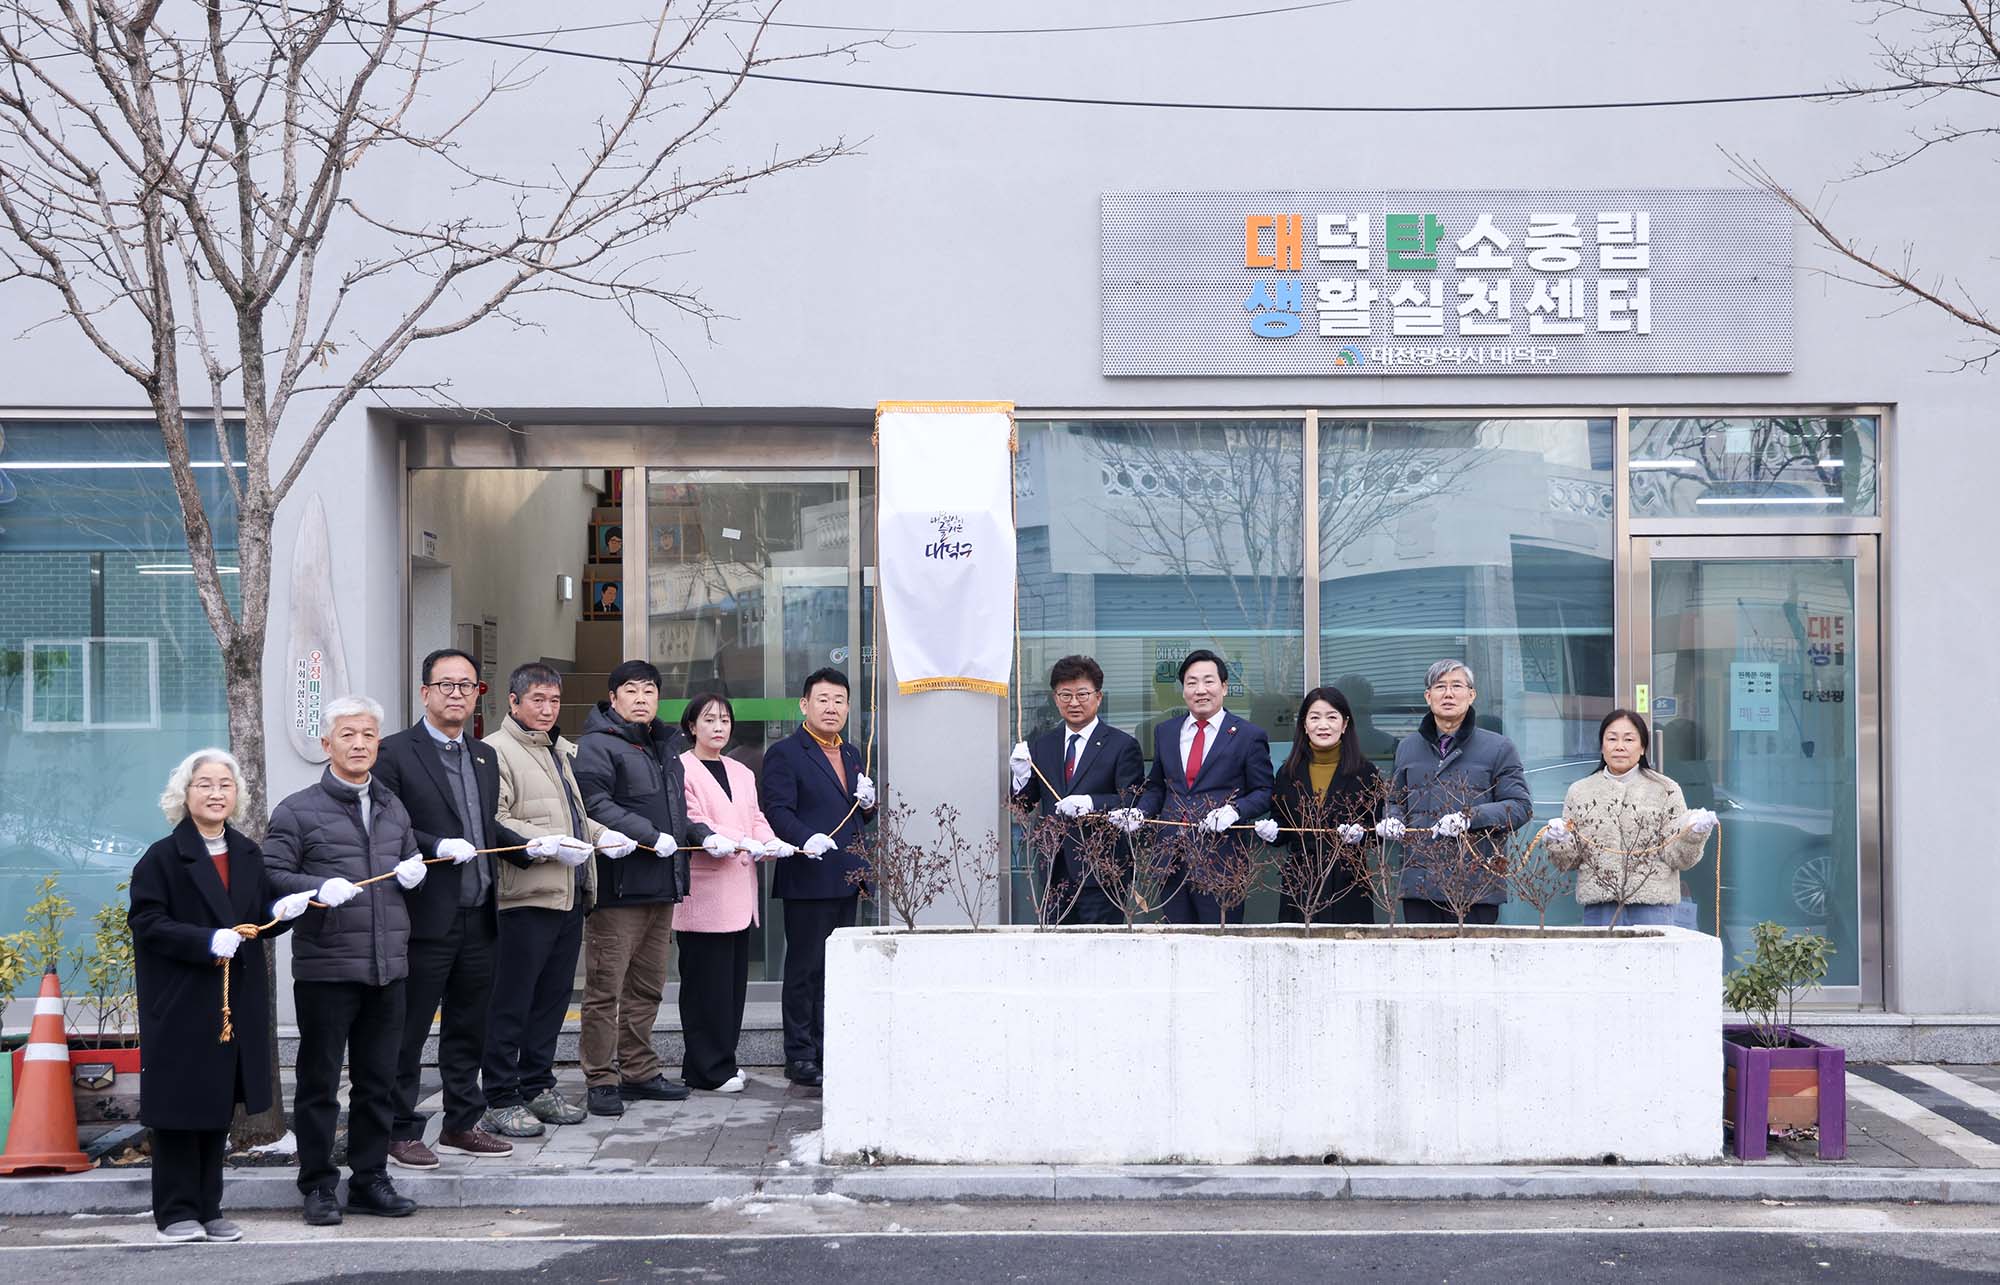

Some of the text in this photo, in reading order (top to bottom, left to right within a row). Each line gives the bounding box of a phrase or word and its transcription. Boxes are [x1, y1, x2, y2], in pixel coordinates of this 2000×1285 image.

[1244, 212, 1652, 272] 대덕탄소중립
[1243, 278, 1652, 338] 생활실천센터
[1371, 345, 1559, 366] 대전광역시 대덕구
[925, 542, 973, 560] 대덕구
[308, 651, 321, 737] 오정마을관리
